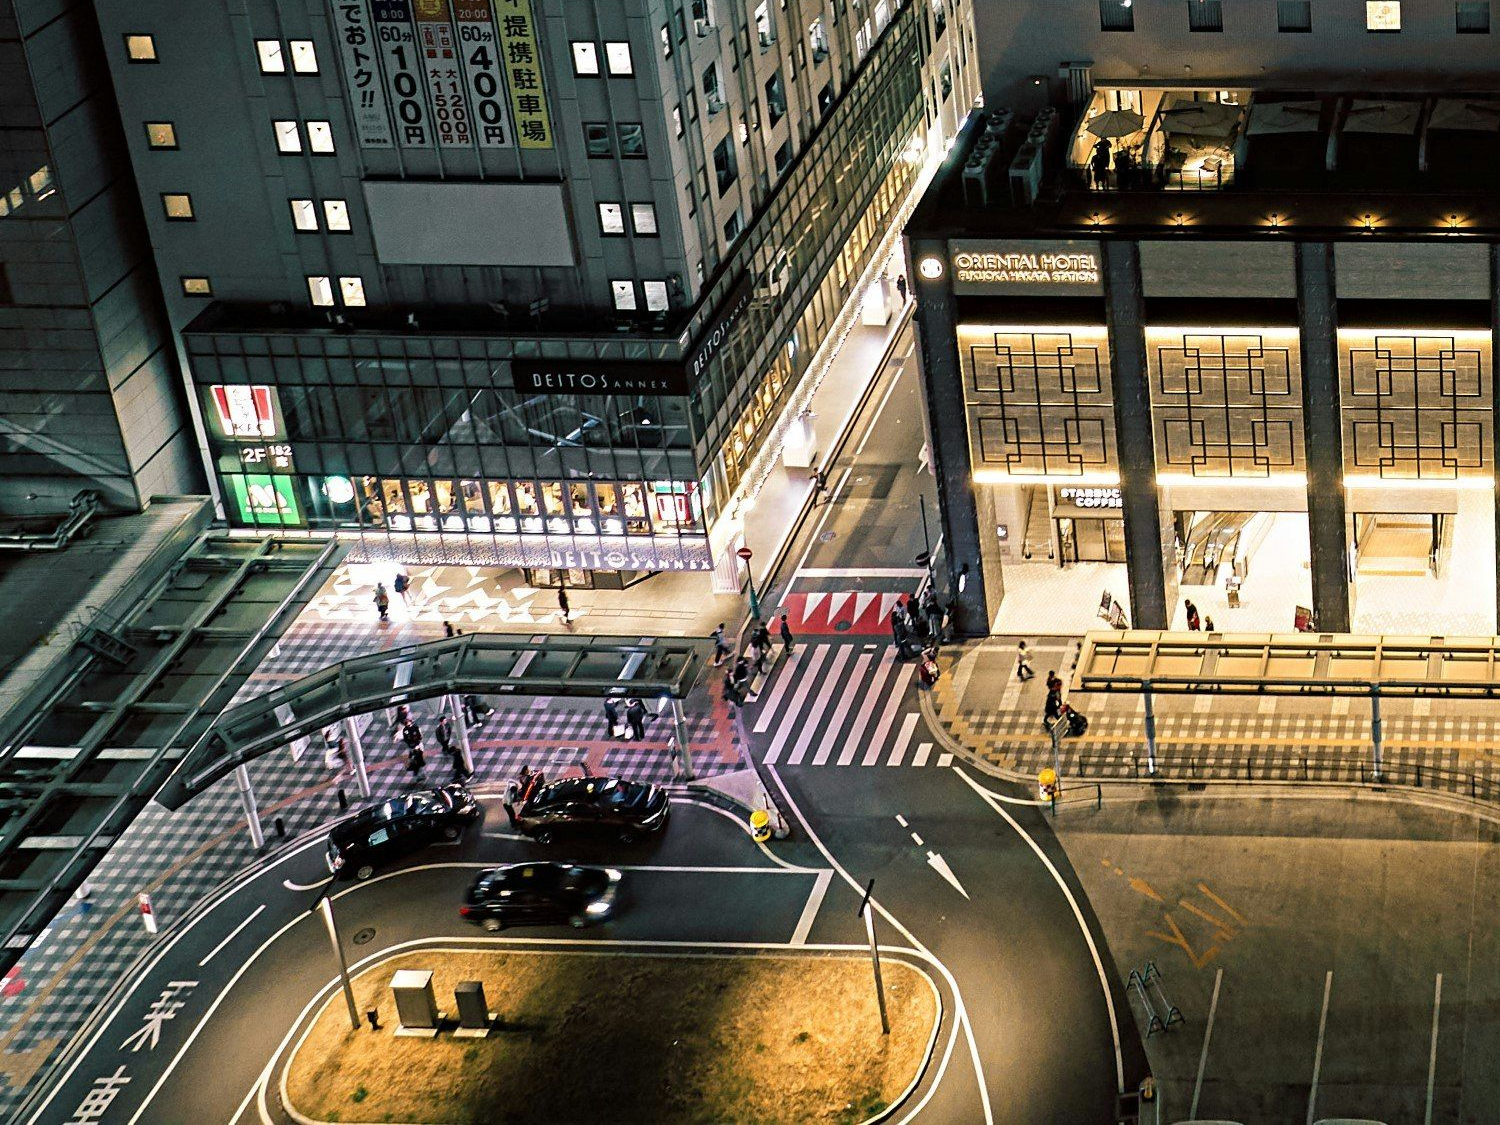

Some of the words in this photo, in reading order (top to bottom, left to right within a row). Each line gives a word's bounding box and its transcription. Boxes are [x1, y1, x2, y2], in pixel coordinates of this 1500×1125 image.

[956, 254, 1038, 271] ORIENTAL
[1042, 254, 1098, 271] HOTEL
[958, 270, 1008, 282] FUKUOKA
[1009, 270, 1050, 282] HAKATA
[1052, 270, 1098, 283] STATION
[532, 373, 608, 388] DEITOS
[614, 380, 669, 389] ANNEX
[242, 448, 267, 463] 2F
[1060, 488, 1121, 498] STARBUC
[645, 559, 711, 570] ANNEX
